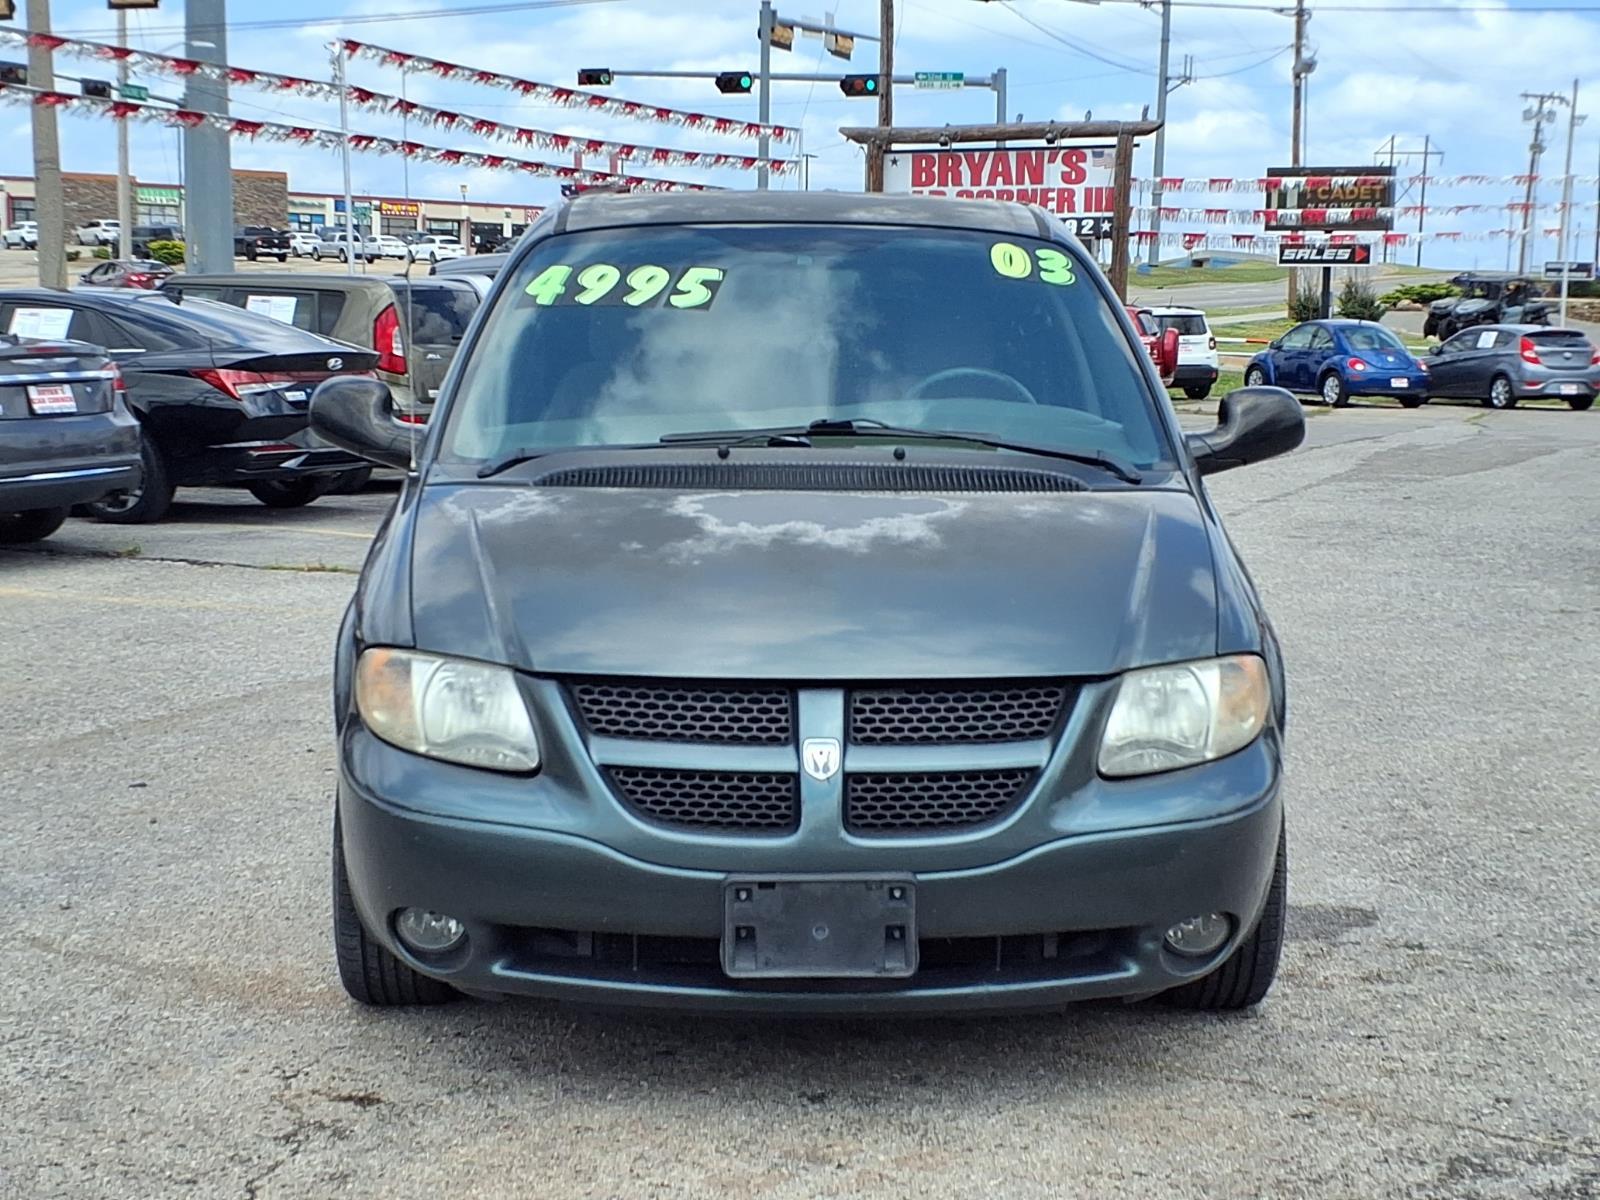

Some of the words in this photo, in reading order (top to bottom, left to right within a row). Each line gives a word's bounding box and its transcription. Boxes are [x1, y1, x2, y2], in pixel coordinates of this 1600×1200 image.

[911, 149, 1087, 188] BRYAN'S
[1317, 185, 1384, 200] CADET
[990, 242, 1077, 286] 03
[1281, 248, 1352, 260] SALES
[525, 264, 723, 309] 4995
